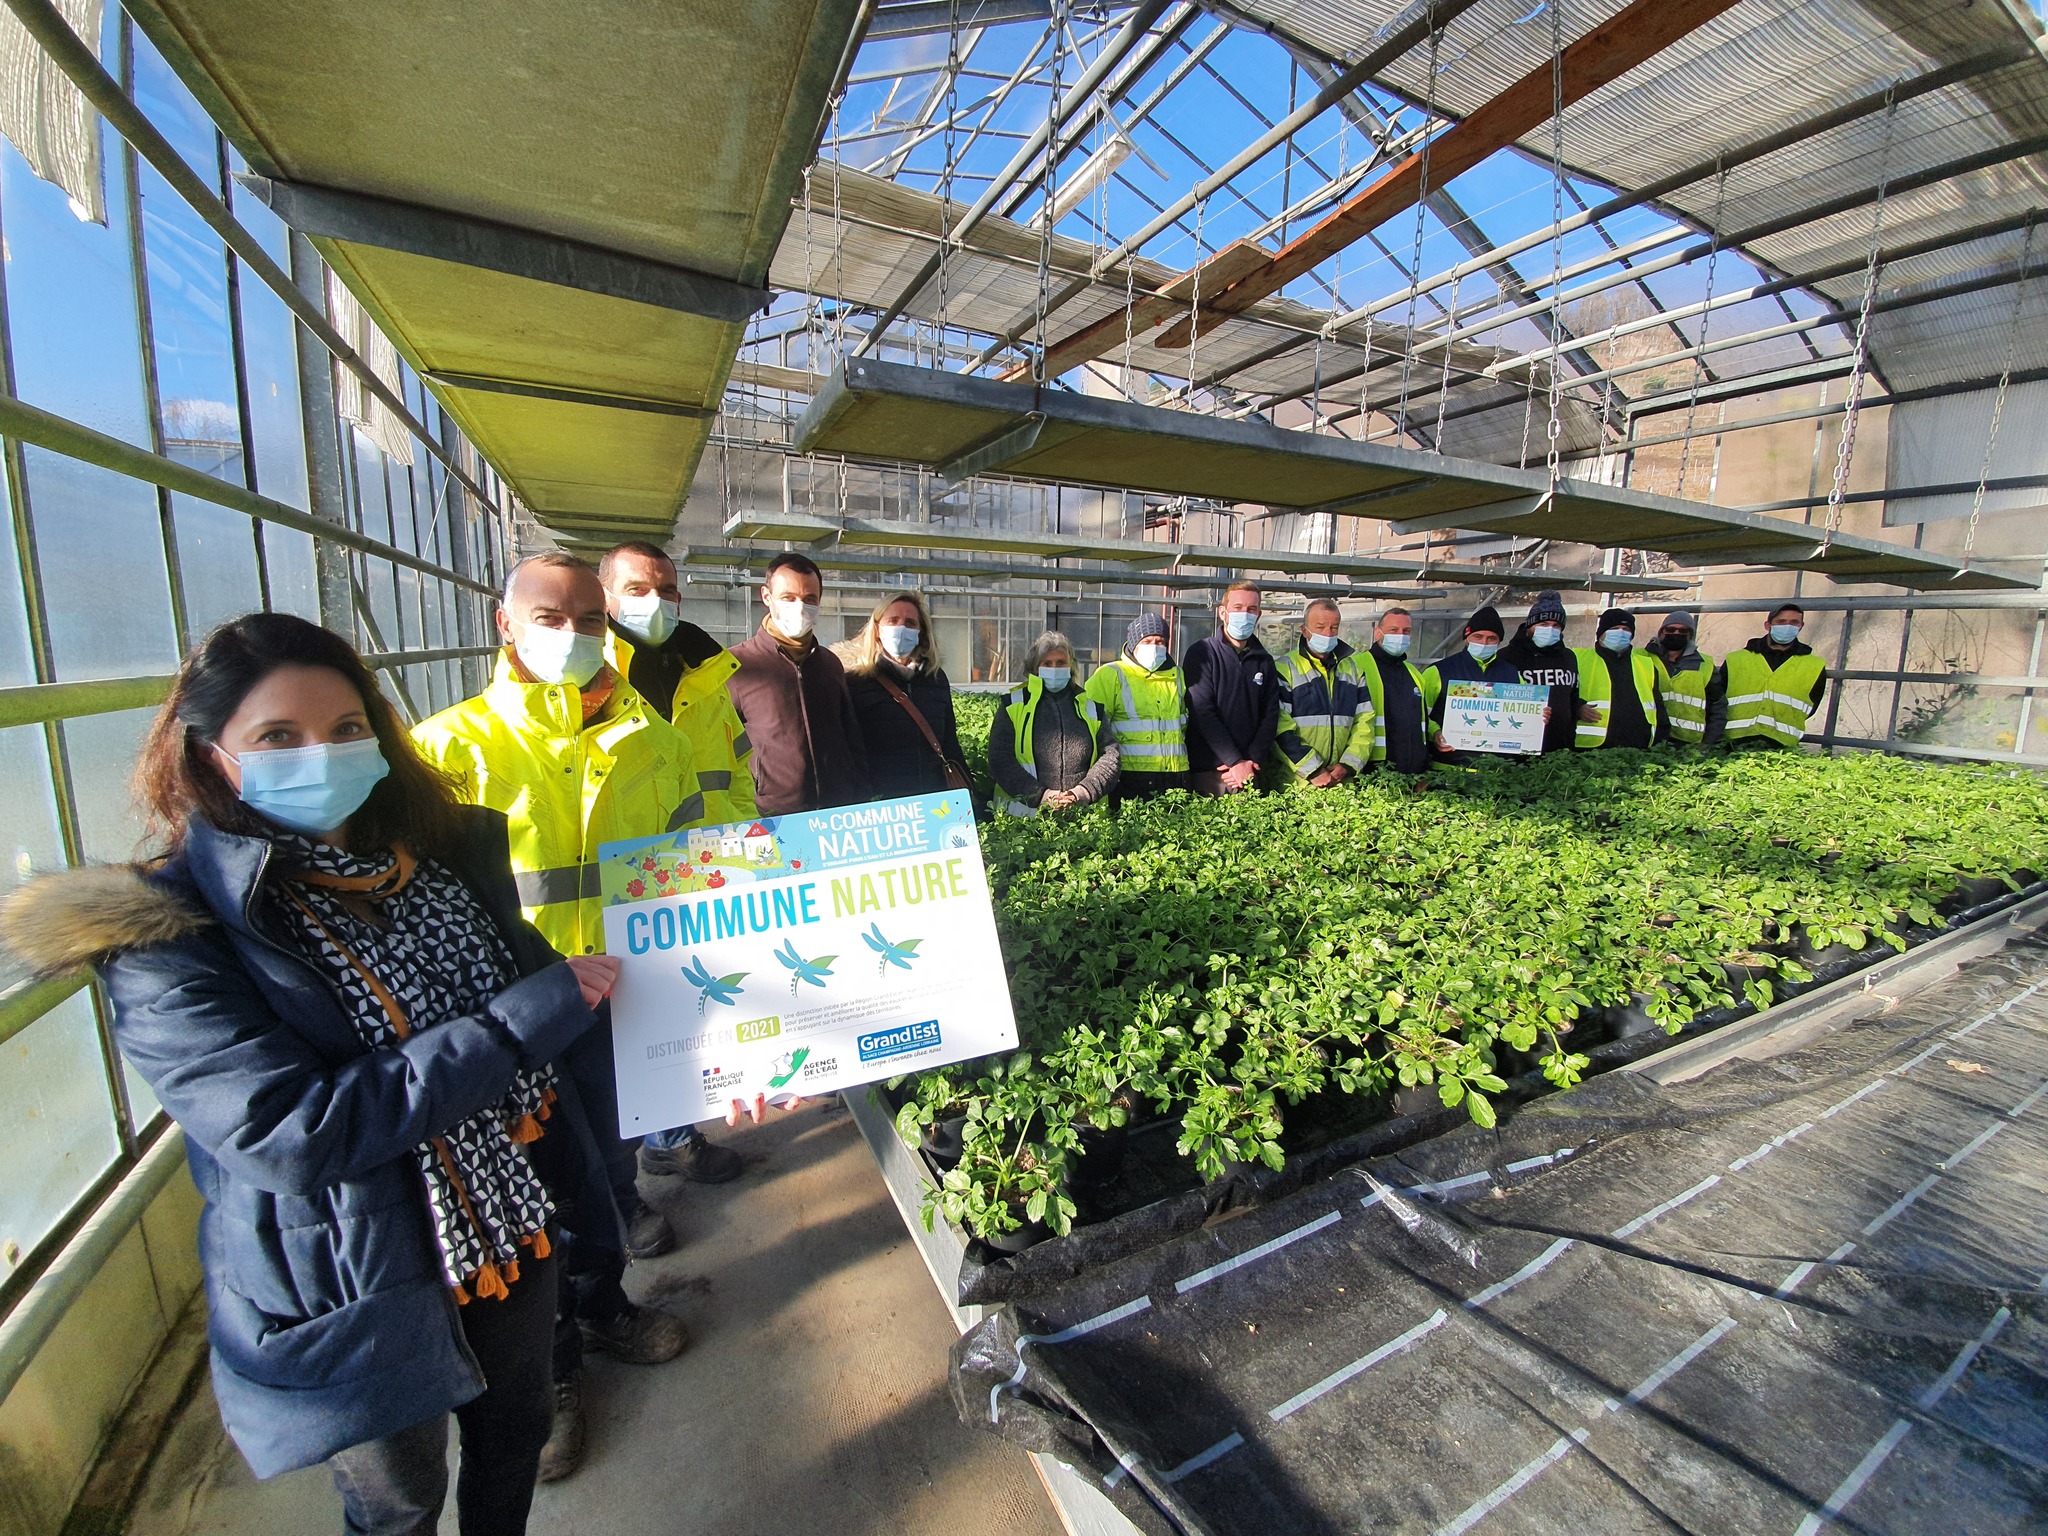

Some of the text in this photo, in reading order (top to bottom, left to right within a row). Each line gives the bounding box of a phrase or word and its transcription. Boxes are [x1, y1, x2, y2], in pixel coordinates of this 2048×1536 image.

[1503, 690, 1535, 699] NATURE
[1450, 698, 1541, 715] COMMUNE NATURE
[808, 801, 925, 832] Ma COMMUNE
[818, 819, 930, 860] NATURE
[626, 857, 968, 955] COMMUNE NATURE
[785, 1019, 797, 1028] pour
[798, 1013, 823, 1024] préserver
[830, 1006, 855, 1017] améliorer
[861, 1001, 879, 1011] qualité
[795, 1007, 823, 1017] distinction
[823, 1003, 840, 1011] initiée
[840, 1001, 849, 1009] par
[855, 996, 873, 1006] Région
[793, 1020, 822, 1032] s'appuyant
[837, 1012, 865, 1024] dynamique
[646, 1018, 775, 1060] DISTINGUÉE EN 2021
[804, 1057, 836, 1070] AGENCE
[816, 1063, 838, 1074] L'EAU
[703, 1071, 744, 1085] RÉPUBLIQUE
[704, 1078, 742, 1091] FRANÇAISE
